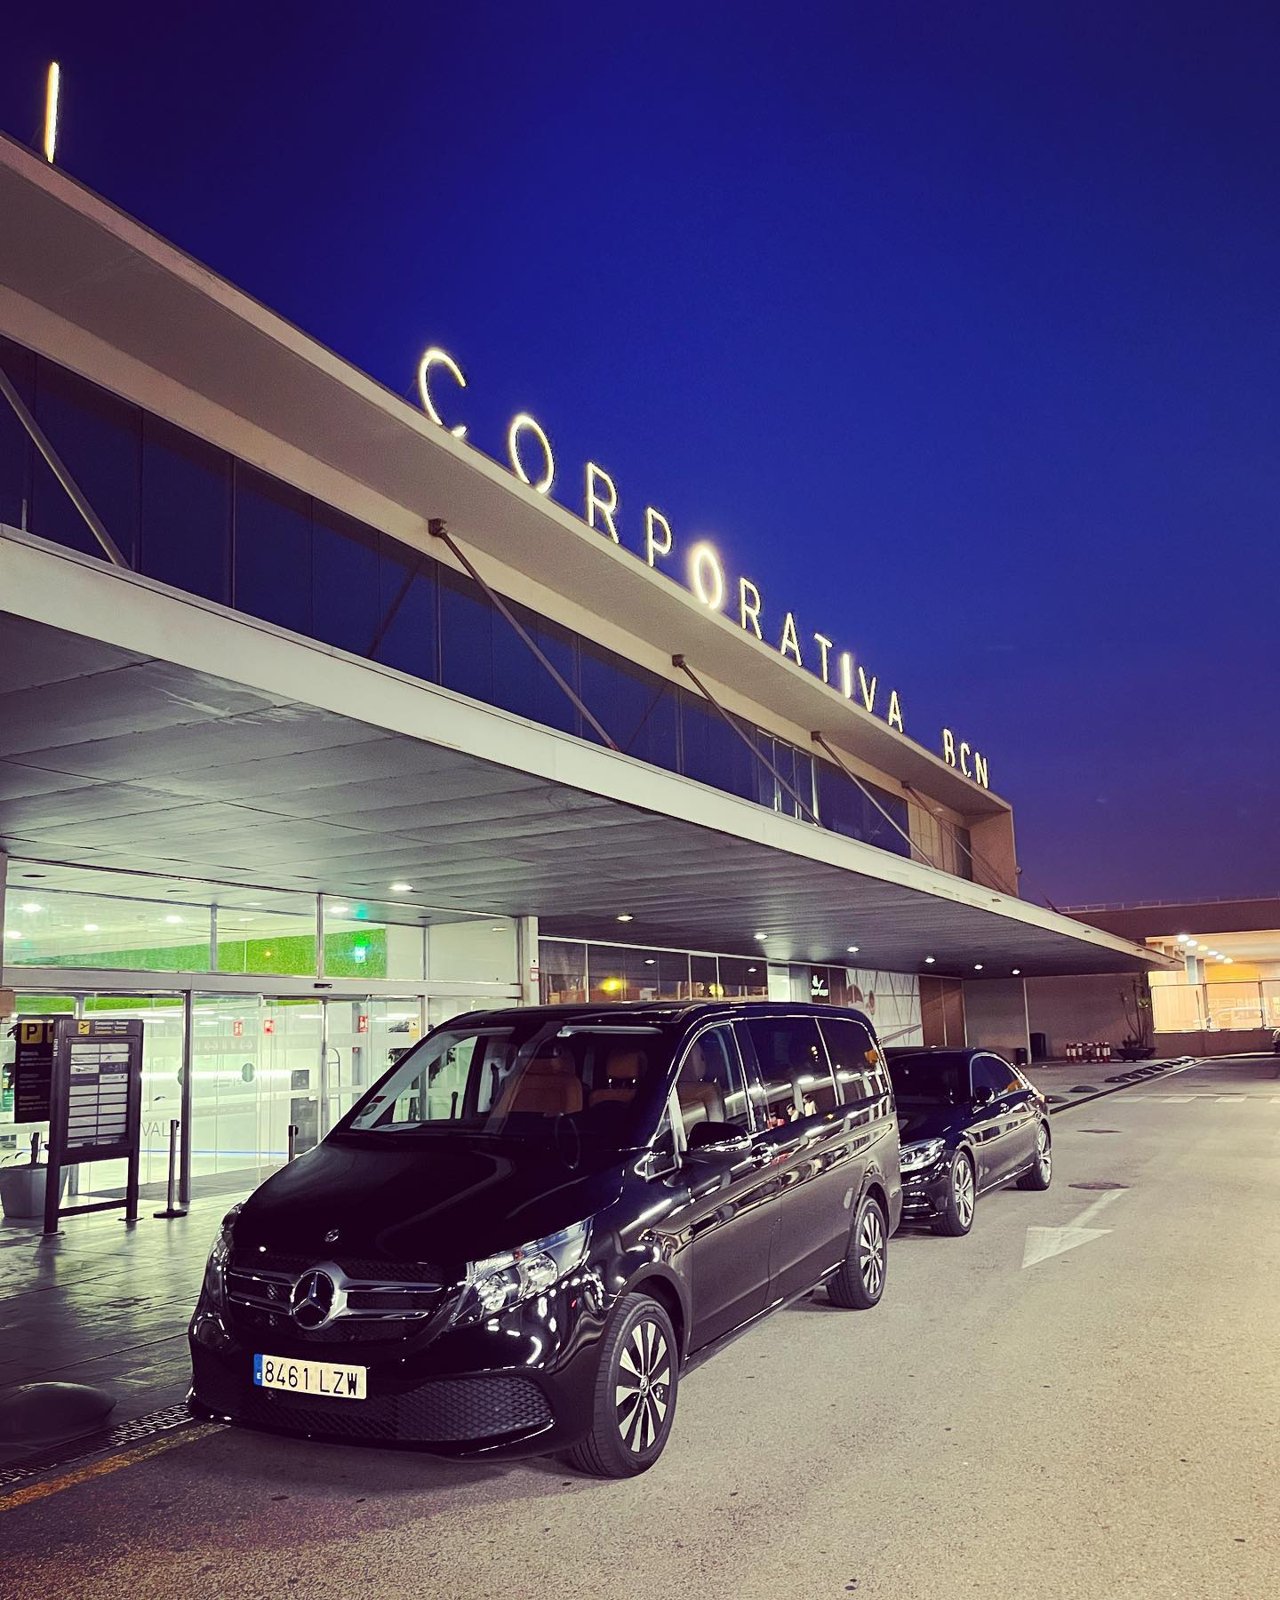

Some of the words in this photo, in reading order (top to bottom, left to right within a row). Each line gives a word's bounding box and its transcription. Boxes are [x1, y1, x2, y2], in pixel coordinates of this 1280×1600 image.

[417, 347, 904, 733] CORPORATIVA
[943, 728, 989, 789] BCN
[26, 1023, 38, 1040] P
[265, 1361, 309, 1391] 8461
[319, 1369, 358, 1396] LZW
